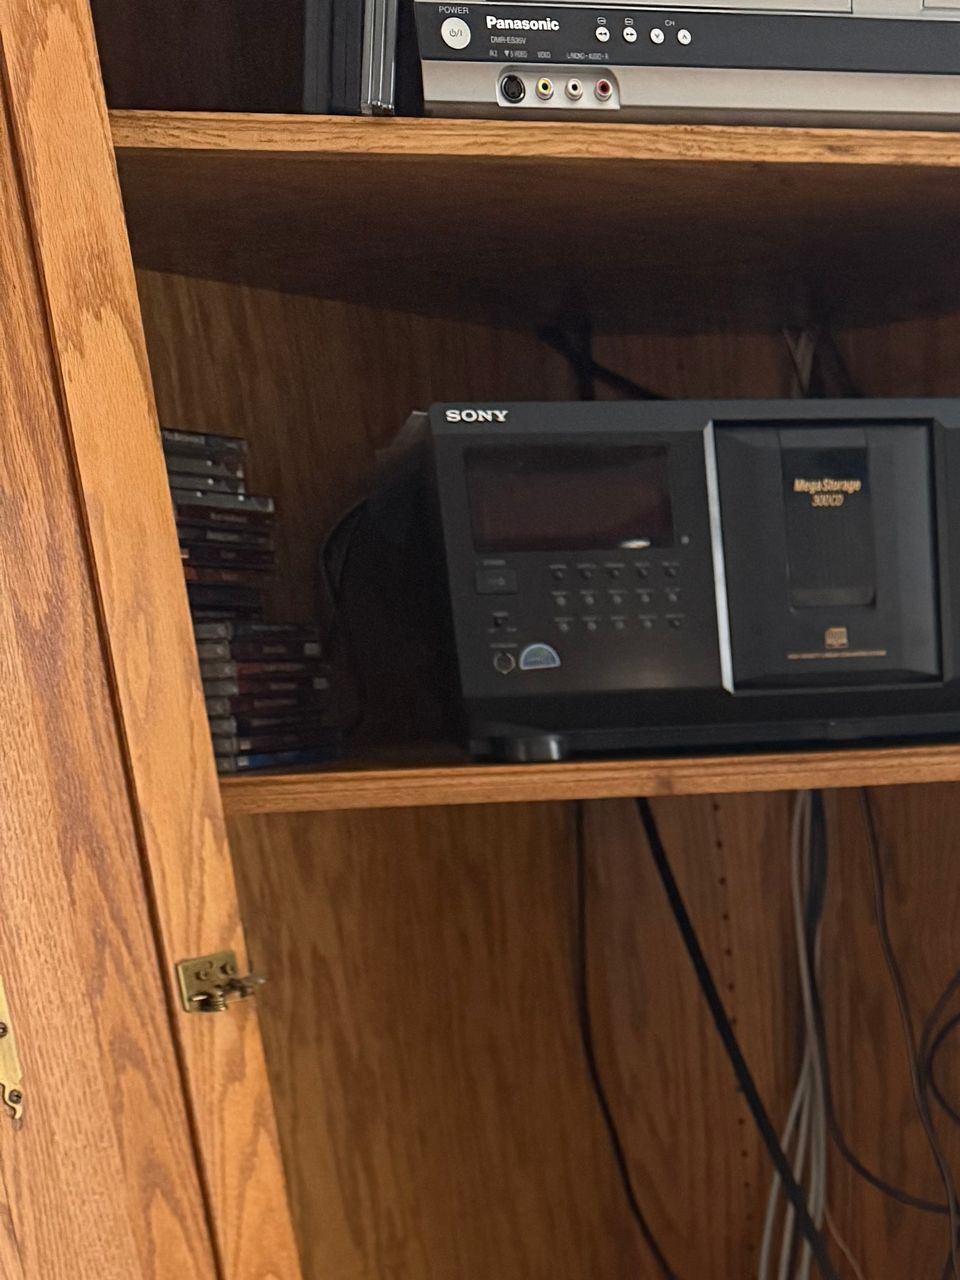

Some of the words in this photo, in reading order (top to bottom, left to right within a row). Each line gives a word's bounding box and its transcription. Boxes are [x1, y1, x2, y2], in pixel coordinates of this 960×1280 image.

[438, 5, 470, 15] POWER
[486, 15, 560, 32] Panasonic
[445, 408, 509, 424] SONY
[794, 479, 821, 494] Mega
[823, 479, 861, 494] Storage
